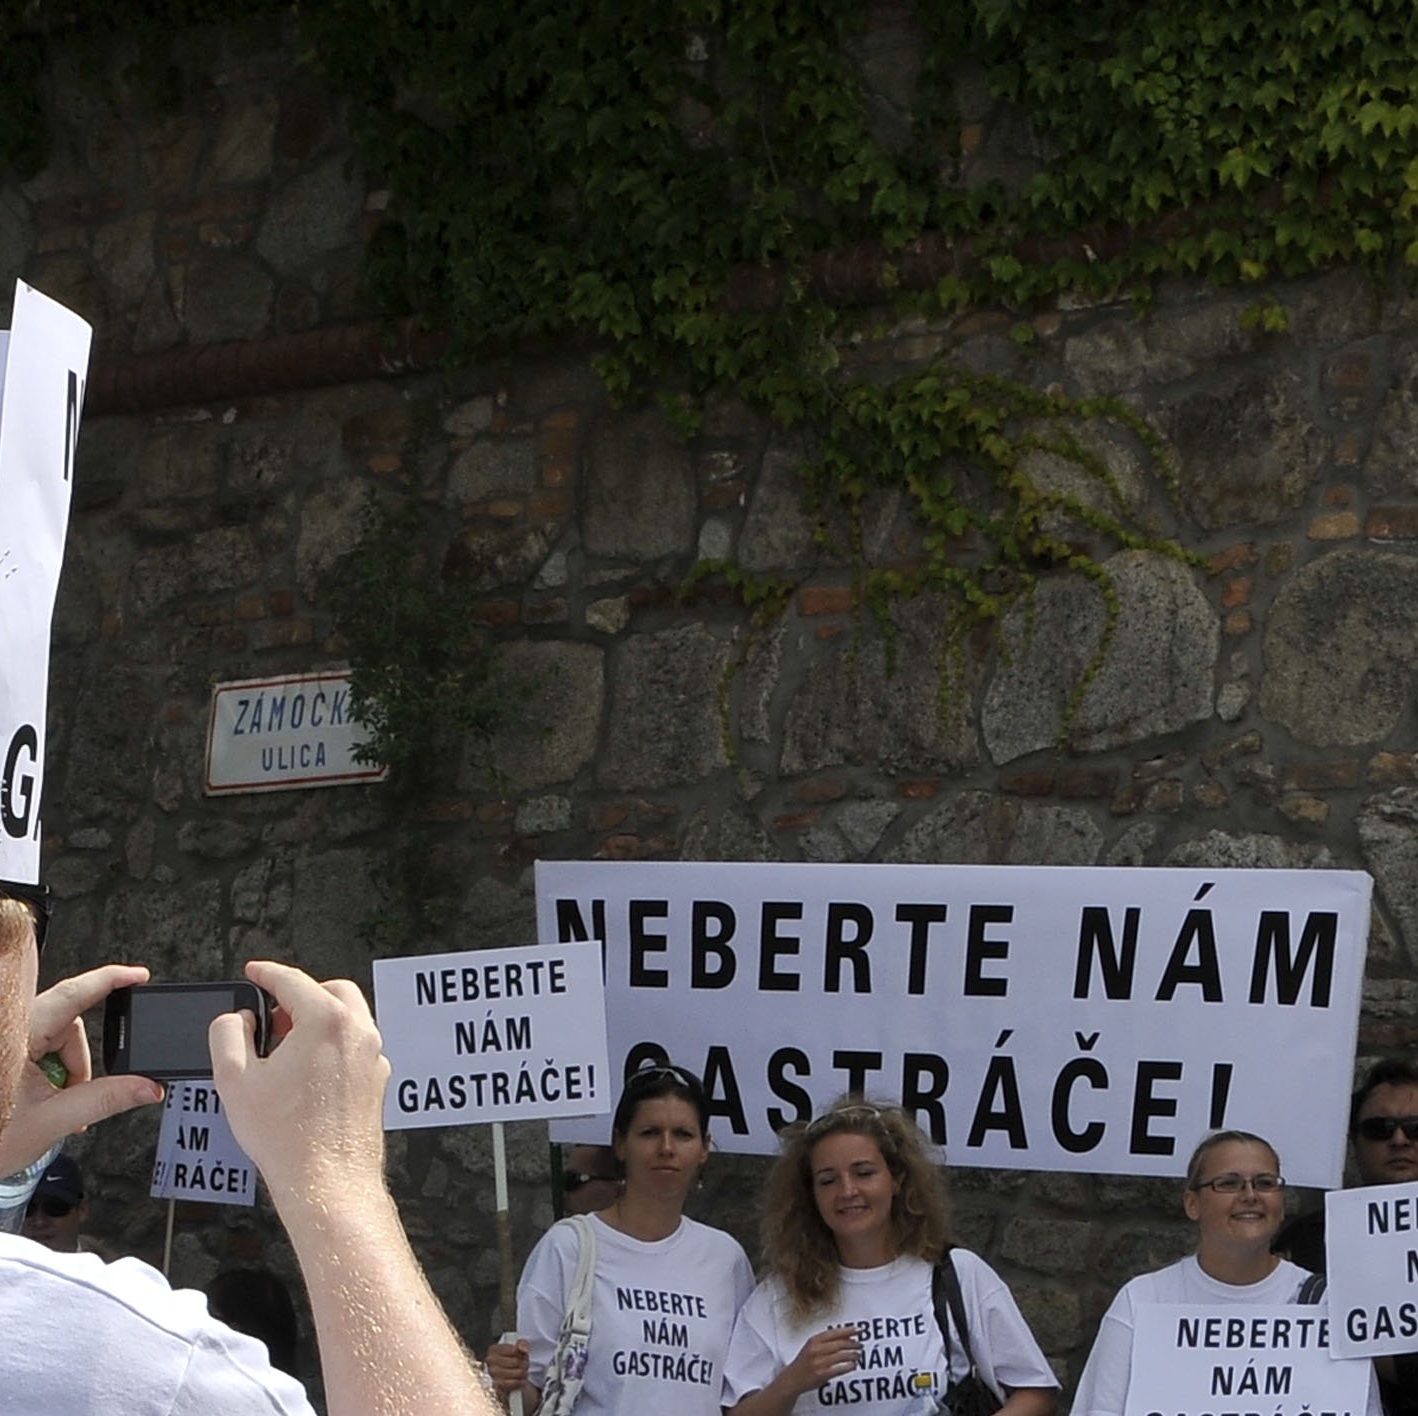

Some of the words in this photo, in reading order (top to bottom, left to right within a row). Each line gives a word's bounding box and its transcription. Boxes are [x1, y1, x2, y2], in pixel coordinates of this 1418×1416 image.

[234, 691, 349, 736] ZÁMOCK
[262, 742, 326, 771] ULICA
[557, 897, 1015, 998] NEBERTE
[1073, 882, 1338, 1008] NÁM
[416, 960, 567, 1006] NEBERTE
[455, 1010, 533, 1056] NÁM
[398, 1062, 595, 1115] GASTRÁČE!
[617, 1287, 707, 1318] NEBERTE
[643, 1317, 689, 1348] NÁM
[1177, 1317, 1330, 1349] NEBERTE
[613, 1347, 712, 1386] GASTRÁČE!
[1211, 1357, 1292, 1396] NÁM
